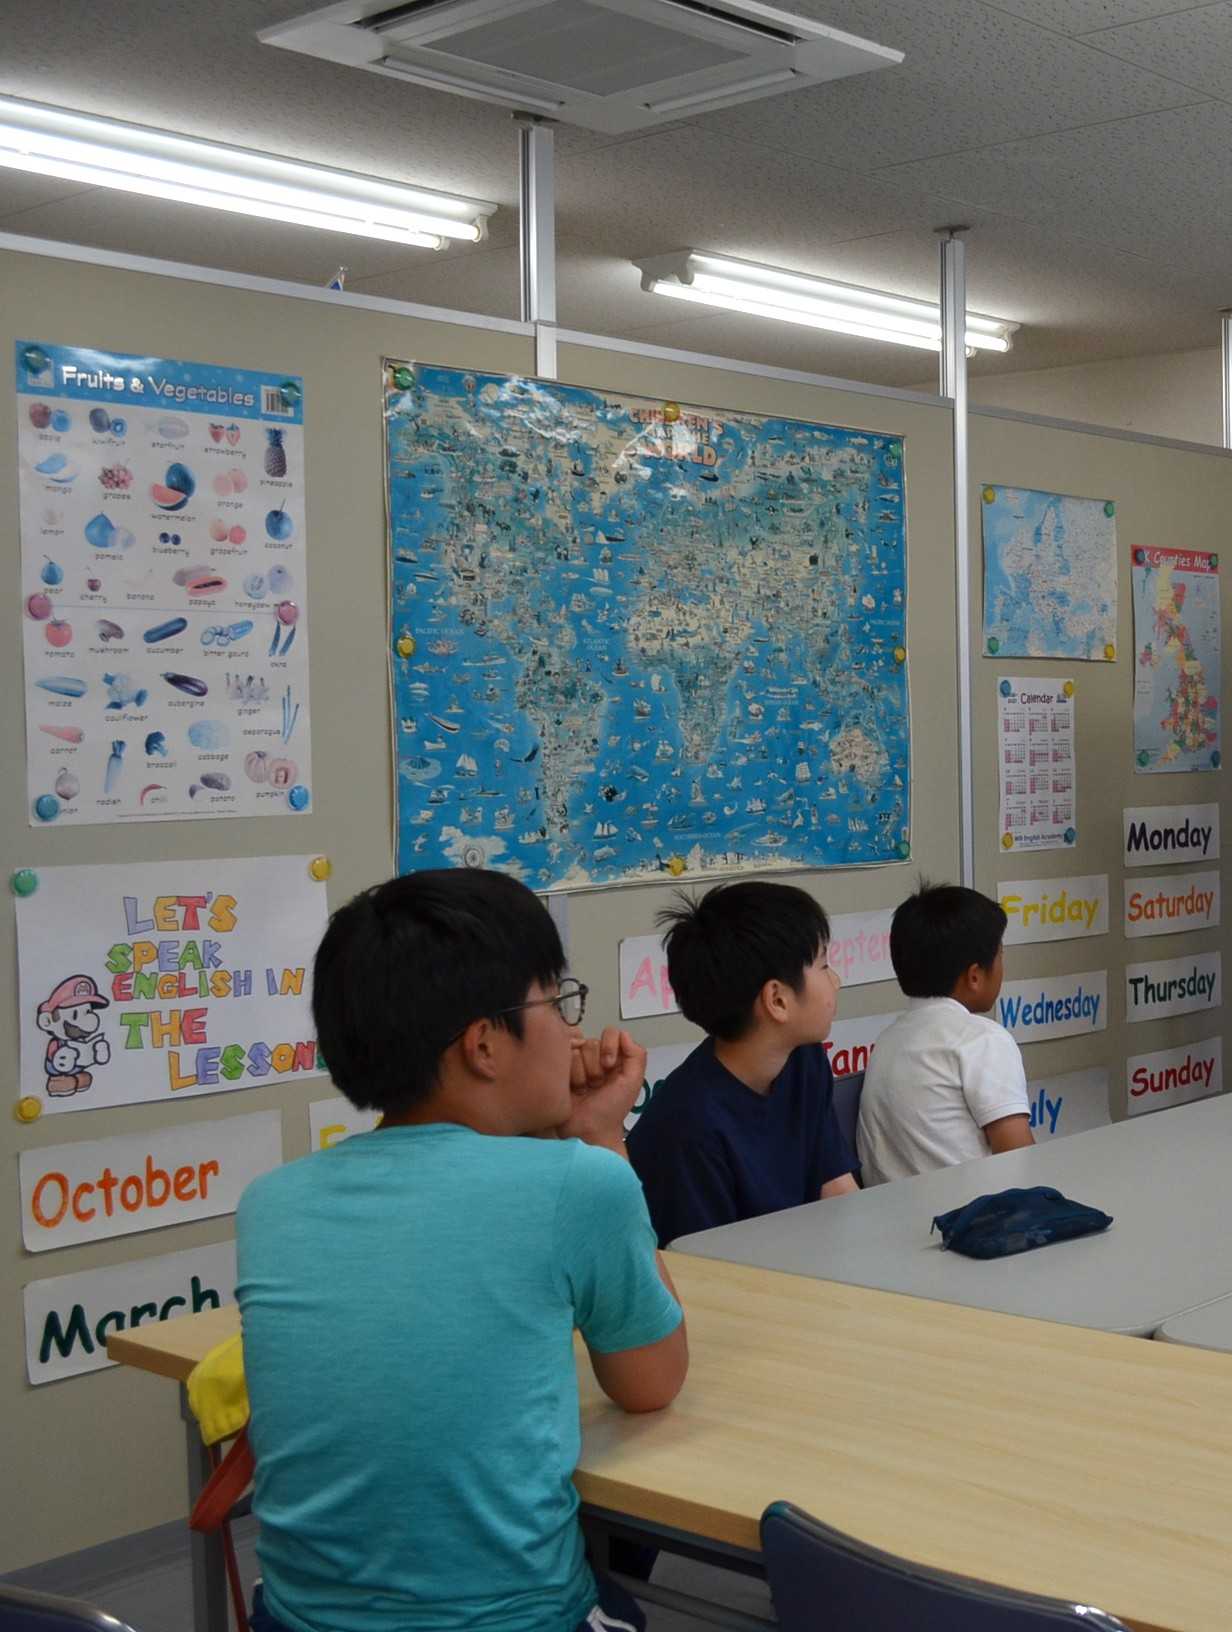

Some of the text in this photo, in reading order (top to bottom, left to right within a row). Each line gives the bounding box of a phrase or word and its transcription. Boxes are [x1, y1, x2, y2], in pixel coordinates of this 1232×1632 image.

[62, 366, 255, 407] Fruits & Vegetables
[1127, 818, 1213, 855] Monday
[123, 892, 238, 935] LET'S
[999, 889, 1099, 929] Friday
[1127, 886, 1214, 922] Saturday
[105, 940, 223, 973] SPEAK
[111, 967, 305, 1001] ENGLISH IN
[1128, 966, 1217, 1006] Thursday
[999, 986, 1101, 1028] Wednesday
[120, 1007, 208, 1050] THE
[168, 1040, 316, 1092] LESSON
[1130, 1054, 1215, 1097] Sunday
[31, 1155, 219, 1229] October
